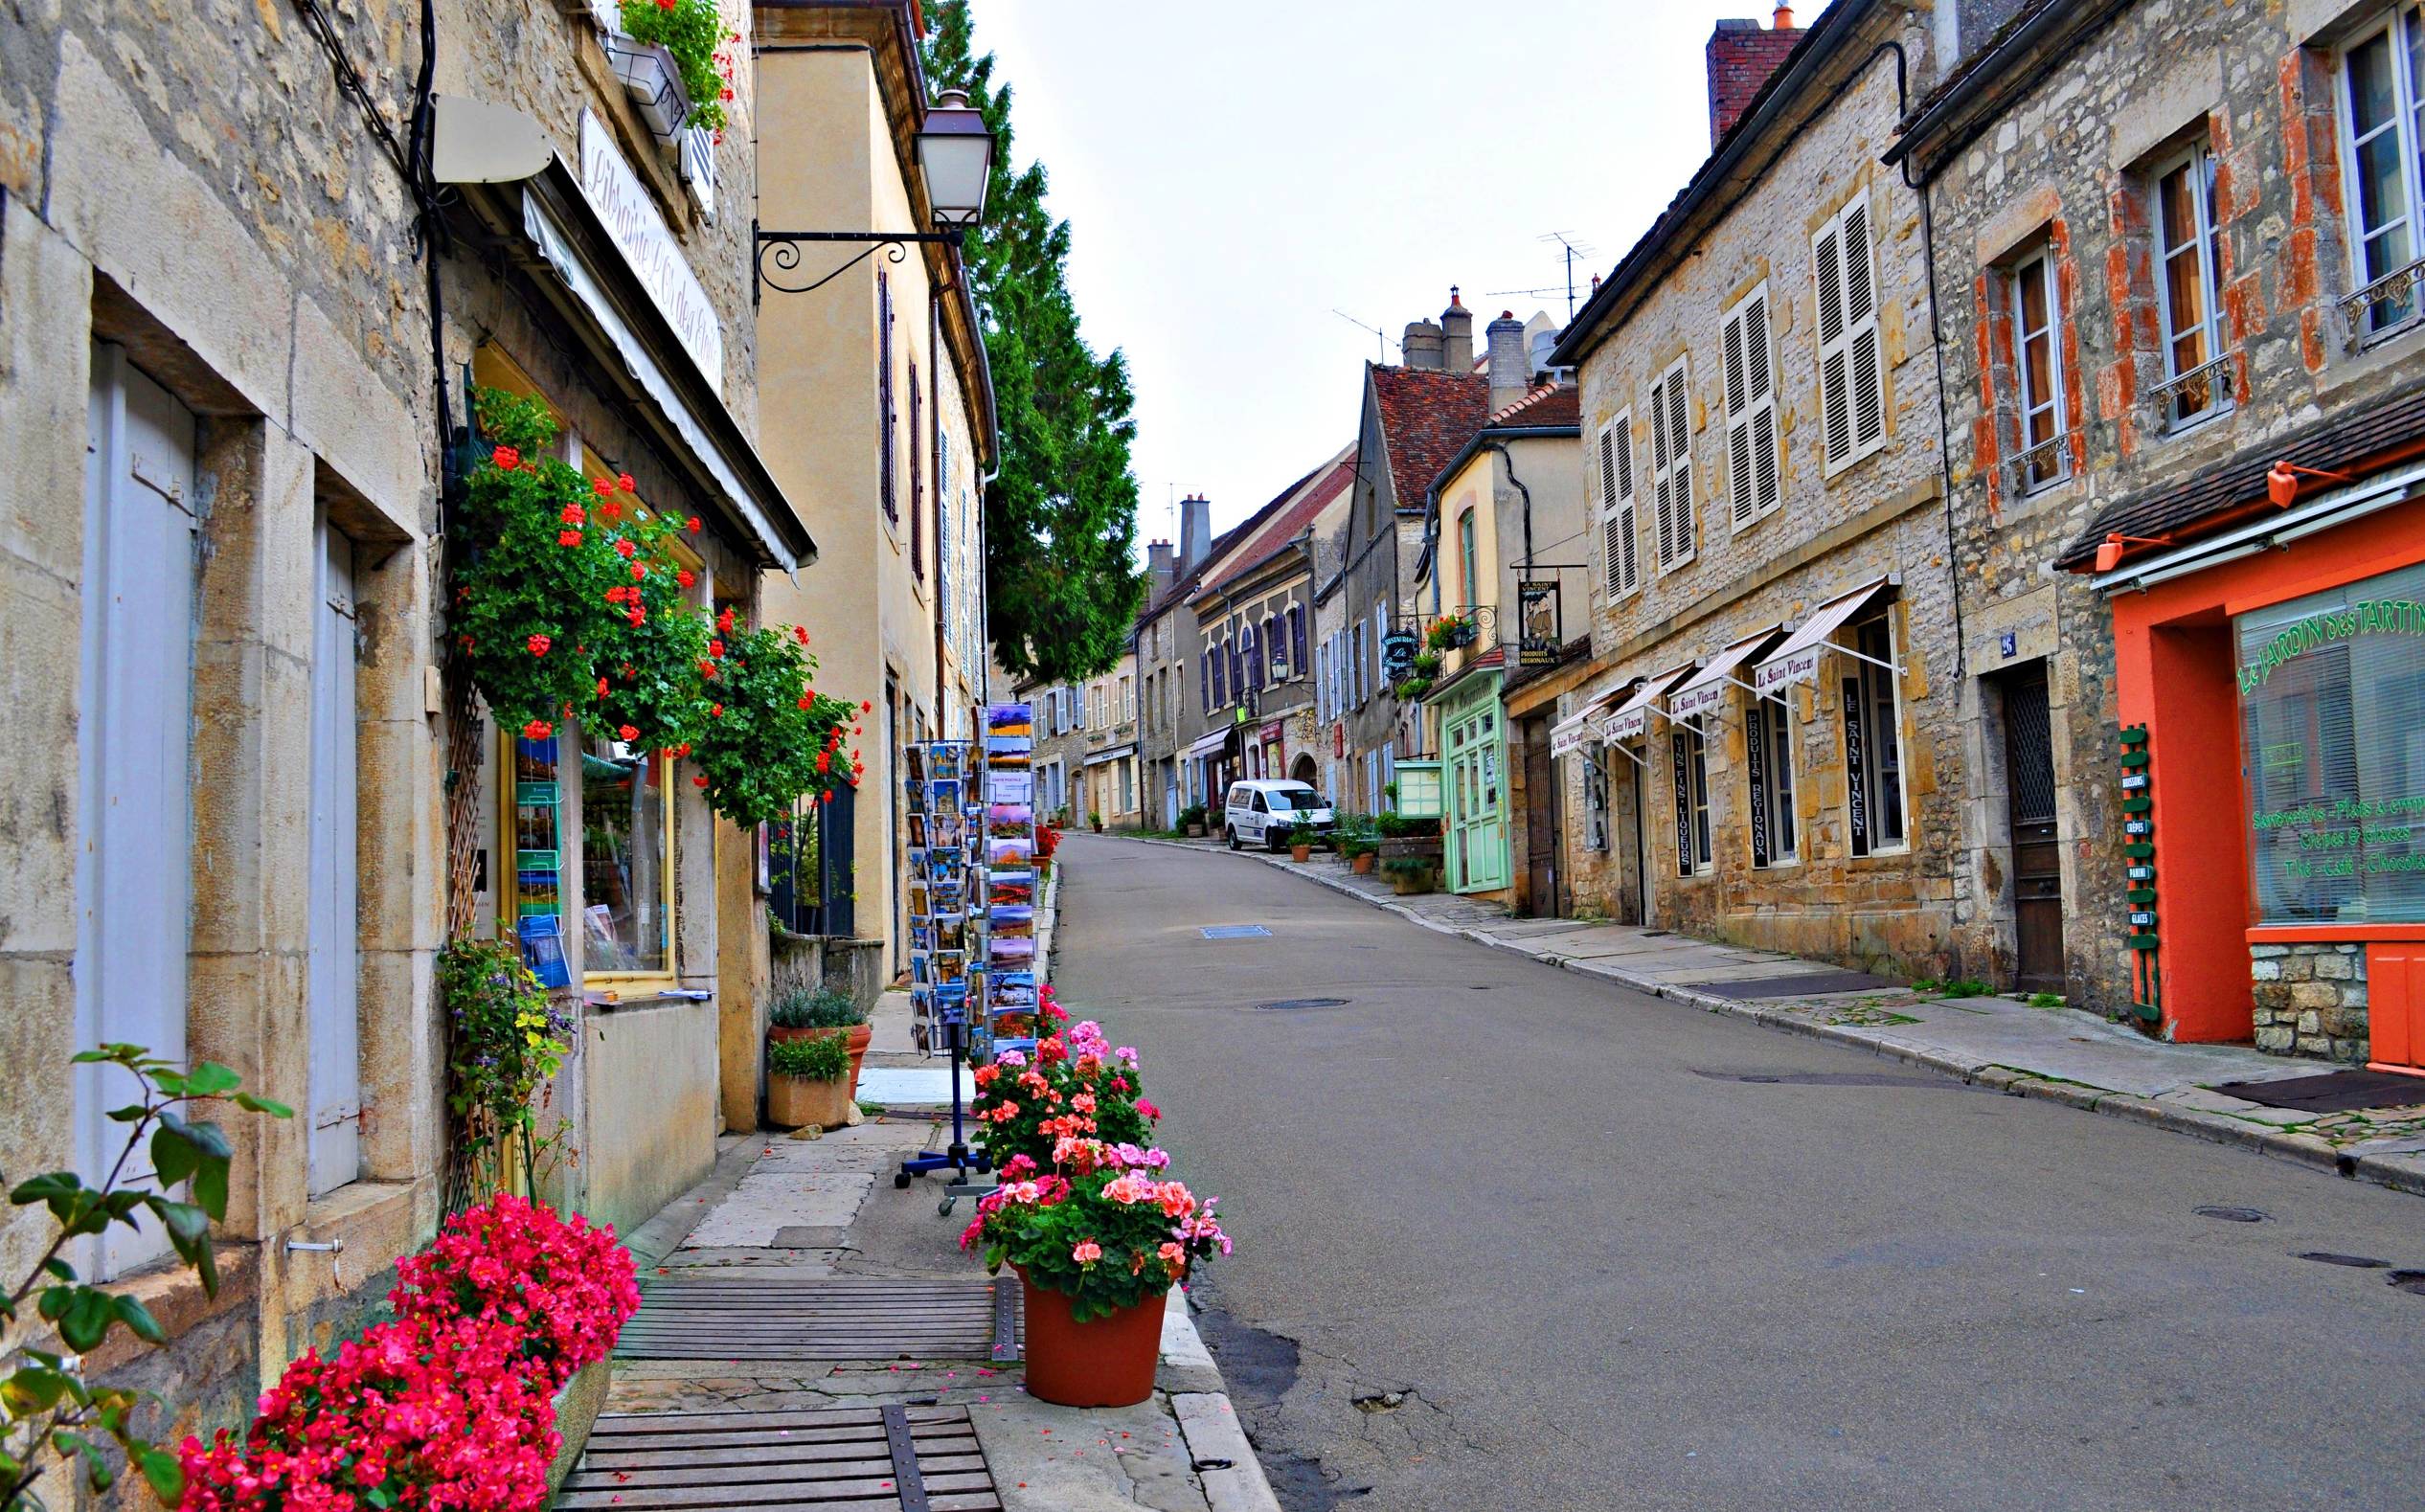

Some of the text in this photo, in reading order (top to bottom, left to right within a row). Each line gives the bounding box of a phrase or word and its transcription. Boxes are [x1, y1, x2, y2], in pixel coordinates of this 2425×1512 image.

[2002, 636, 2012, 655] 26
[2236, 663, 2259, 696] Le
[2257, 612, 2324, 686] JARDIN
[2324, 610, 2356, 641] des
[1767, 667, 1786, 684] Saint
[1787, 656, 1814, 676] Vincent
[1680, 695, 1696, 711] Saint
[1611, 721, 1624, 733] Saint
[1557, 736, 1568, 747] Saint
[1846, 693, 1865, 837] LE SAINT VINCENT
[1748, 714, 1766, 856] PRODUITS REGIONAUX
[2121, 774, 2144, 789] BOISSONS
[1675, 738, 1690, 867] VINS FINS LIQUEURS
[2125, 821, 2144, 833] CRÊPES
[2131, 913, 2148, 924] GLACES
